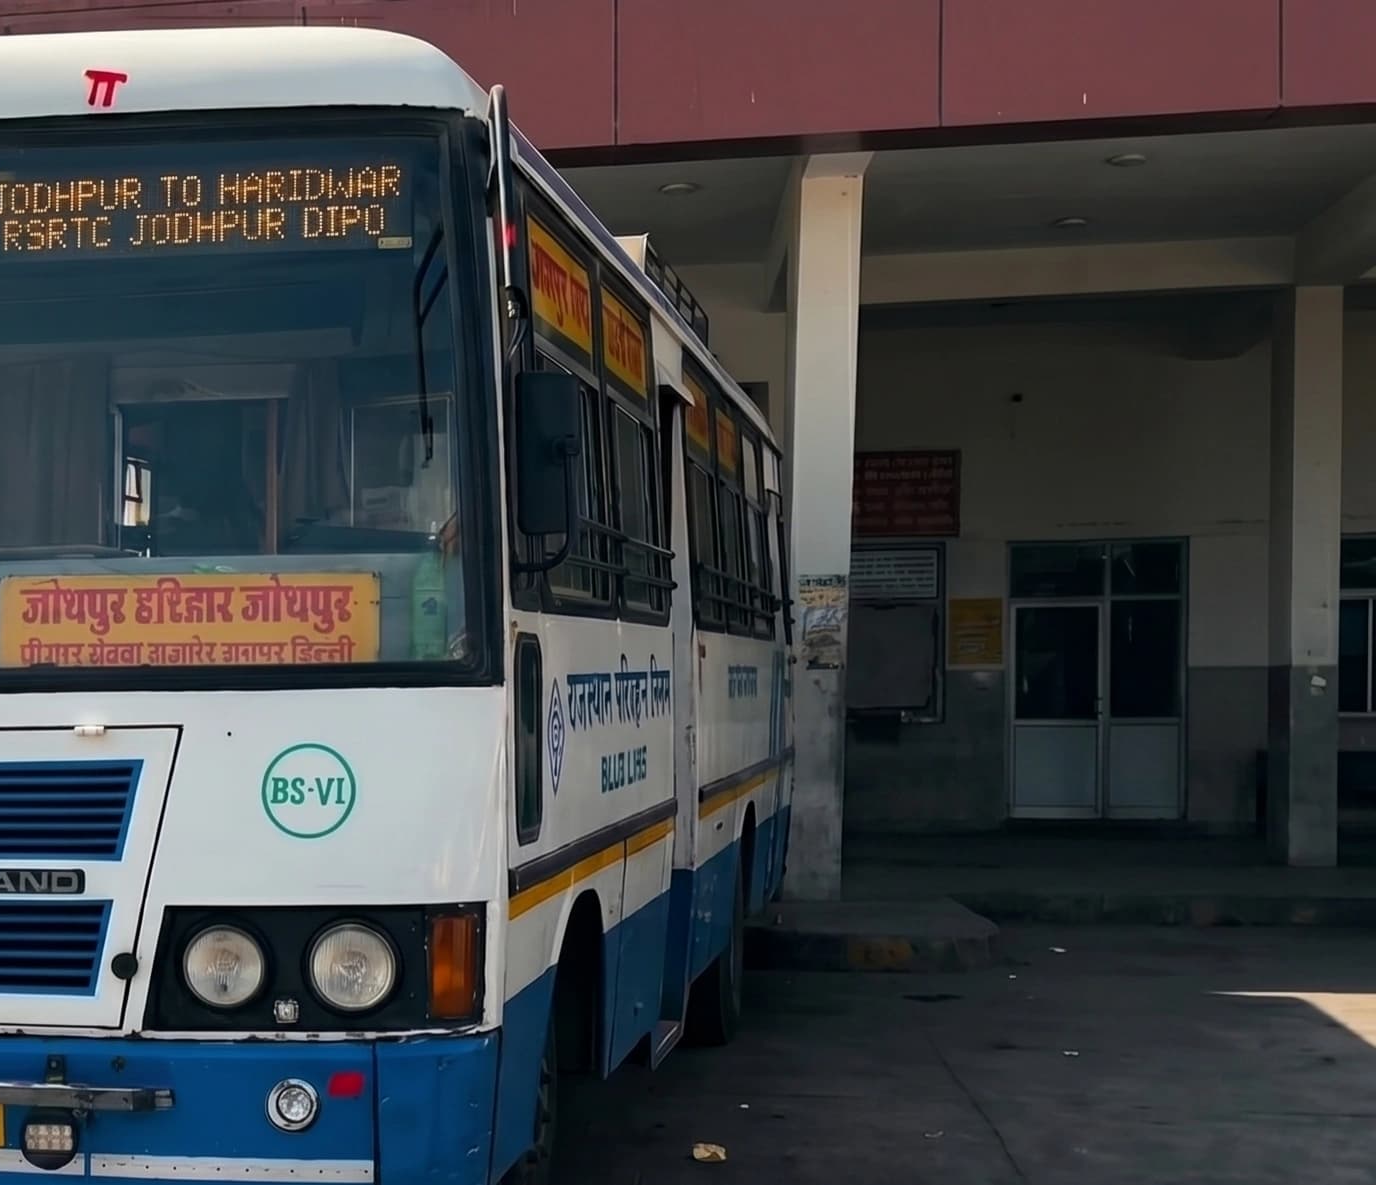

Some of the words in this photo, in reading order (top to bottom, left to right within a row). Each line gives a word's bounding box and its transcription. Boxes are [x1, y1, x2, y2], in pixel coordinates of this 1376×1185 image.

[160, 175, 202, 208] TO
[220, 165, 401, 205] HARIDWAR
[3, 216, 112, 252] RSRTC
[129, 207, 285, 246] JODHPUR
[303, 204, 384, 239] DIPO
[270, 777, 346, 806] BS-VI
